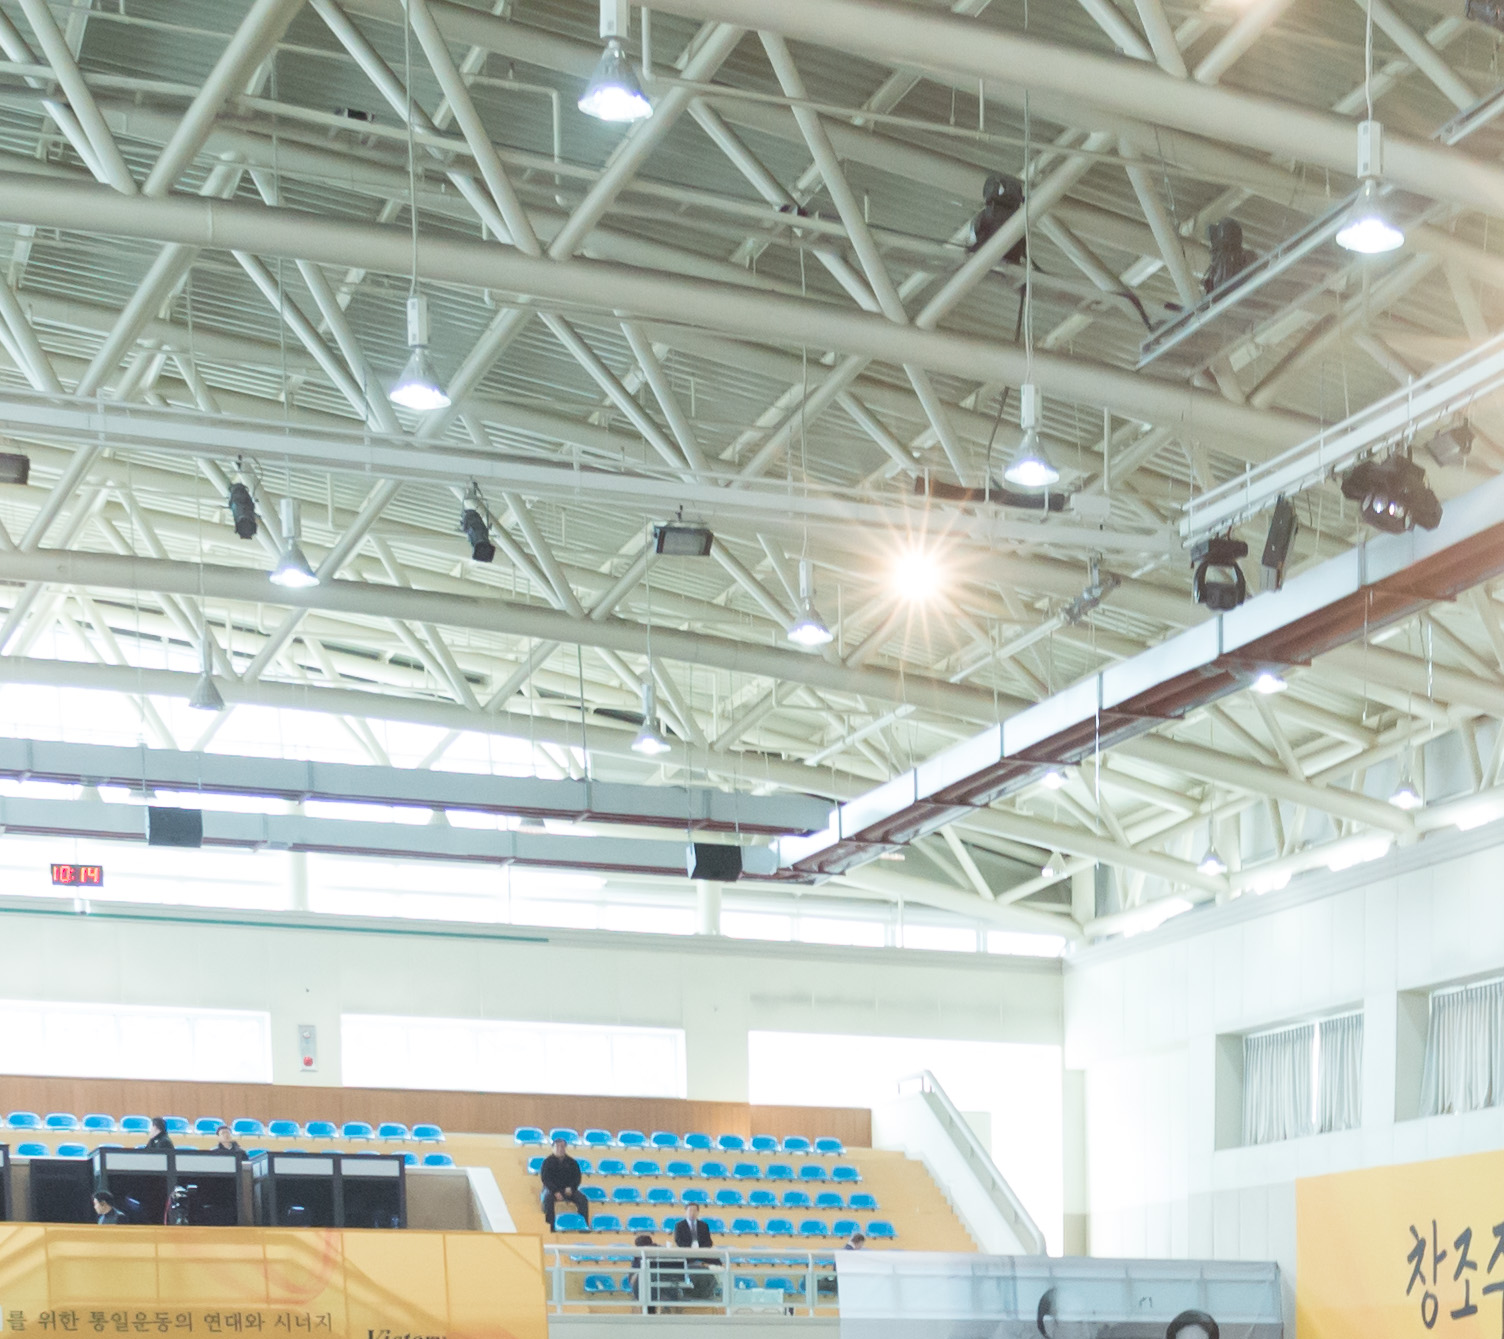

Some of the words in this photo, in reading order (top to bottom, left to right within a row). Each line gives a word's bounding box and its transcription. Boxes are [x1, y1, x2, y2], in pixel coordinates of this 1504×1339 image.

[52, 865, 100, 884] 10:14
[38, 1309, 80, 1332] 위한
[88, 1311, 193, 1333] 통일운동의
[203, 1311, 265, 1333] 연대와
[274, 1311, 333, 1333] 시너지
